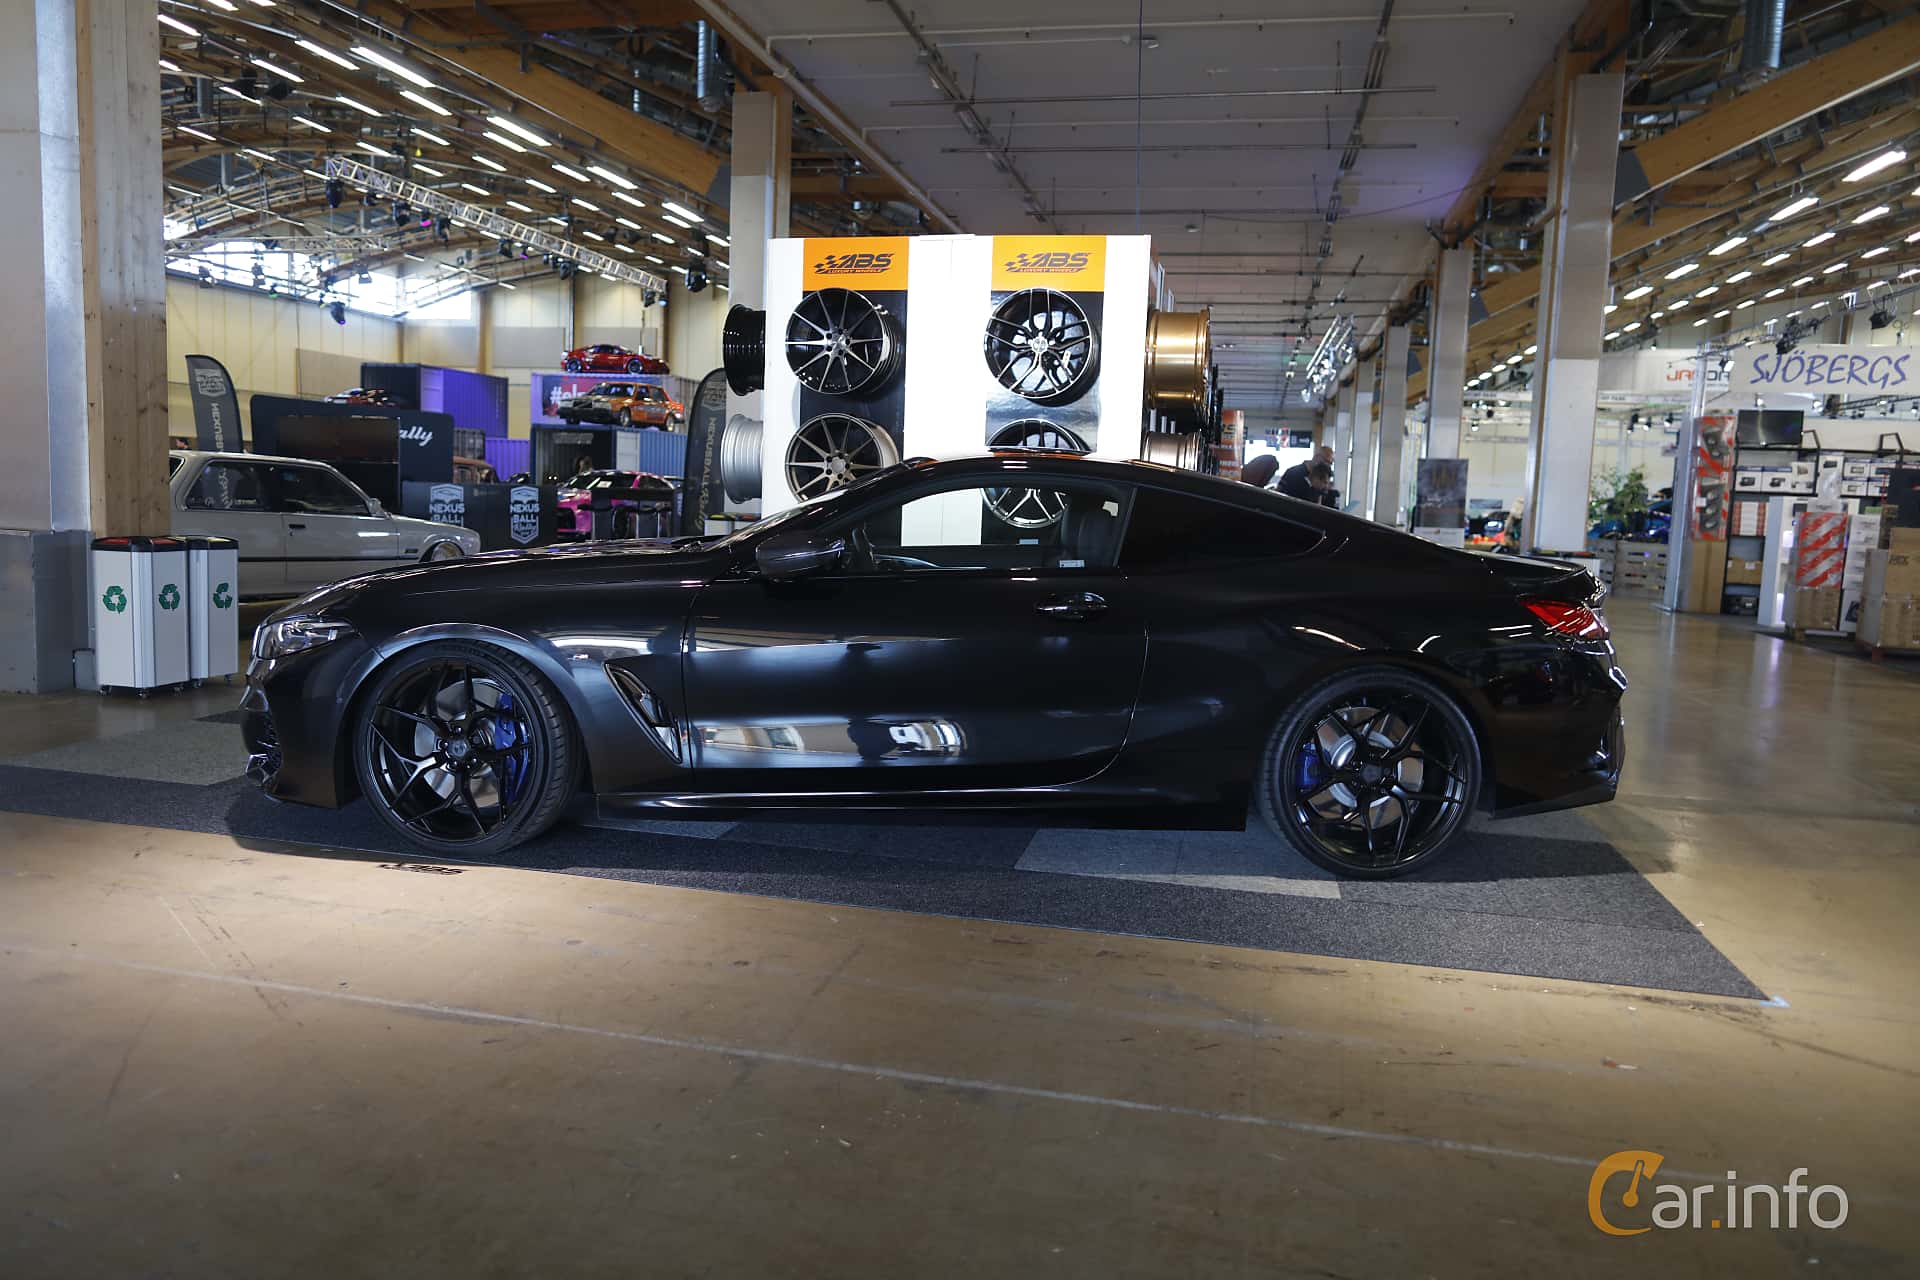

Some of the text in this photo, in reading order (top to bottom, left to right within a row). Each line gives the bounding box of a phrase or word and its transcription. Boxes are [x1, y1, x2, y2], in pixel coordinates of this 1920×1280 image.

[837, 253, 894, 268] ABS
[1029, 252, 1090, 268] ABS
[1750, 351, 1911, 390] SJÖBERGS
[399, 425, 433, 447] ally
[429, 503, 465, 513] NEXUS
[511, 503, 540, 513] NEXUS
[433, 514, 462, 524] BALL
[513, 514, 537, 523] BALL
